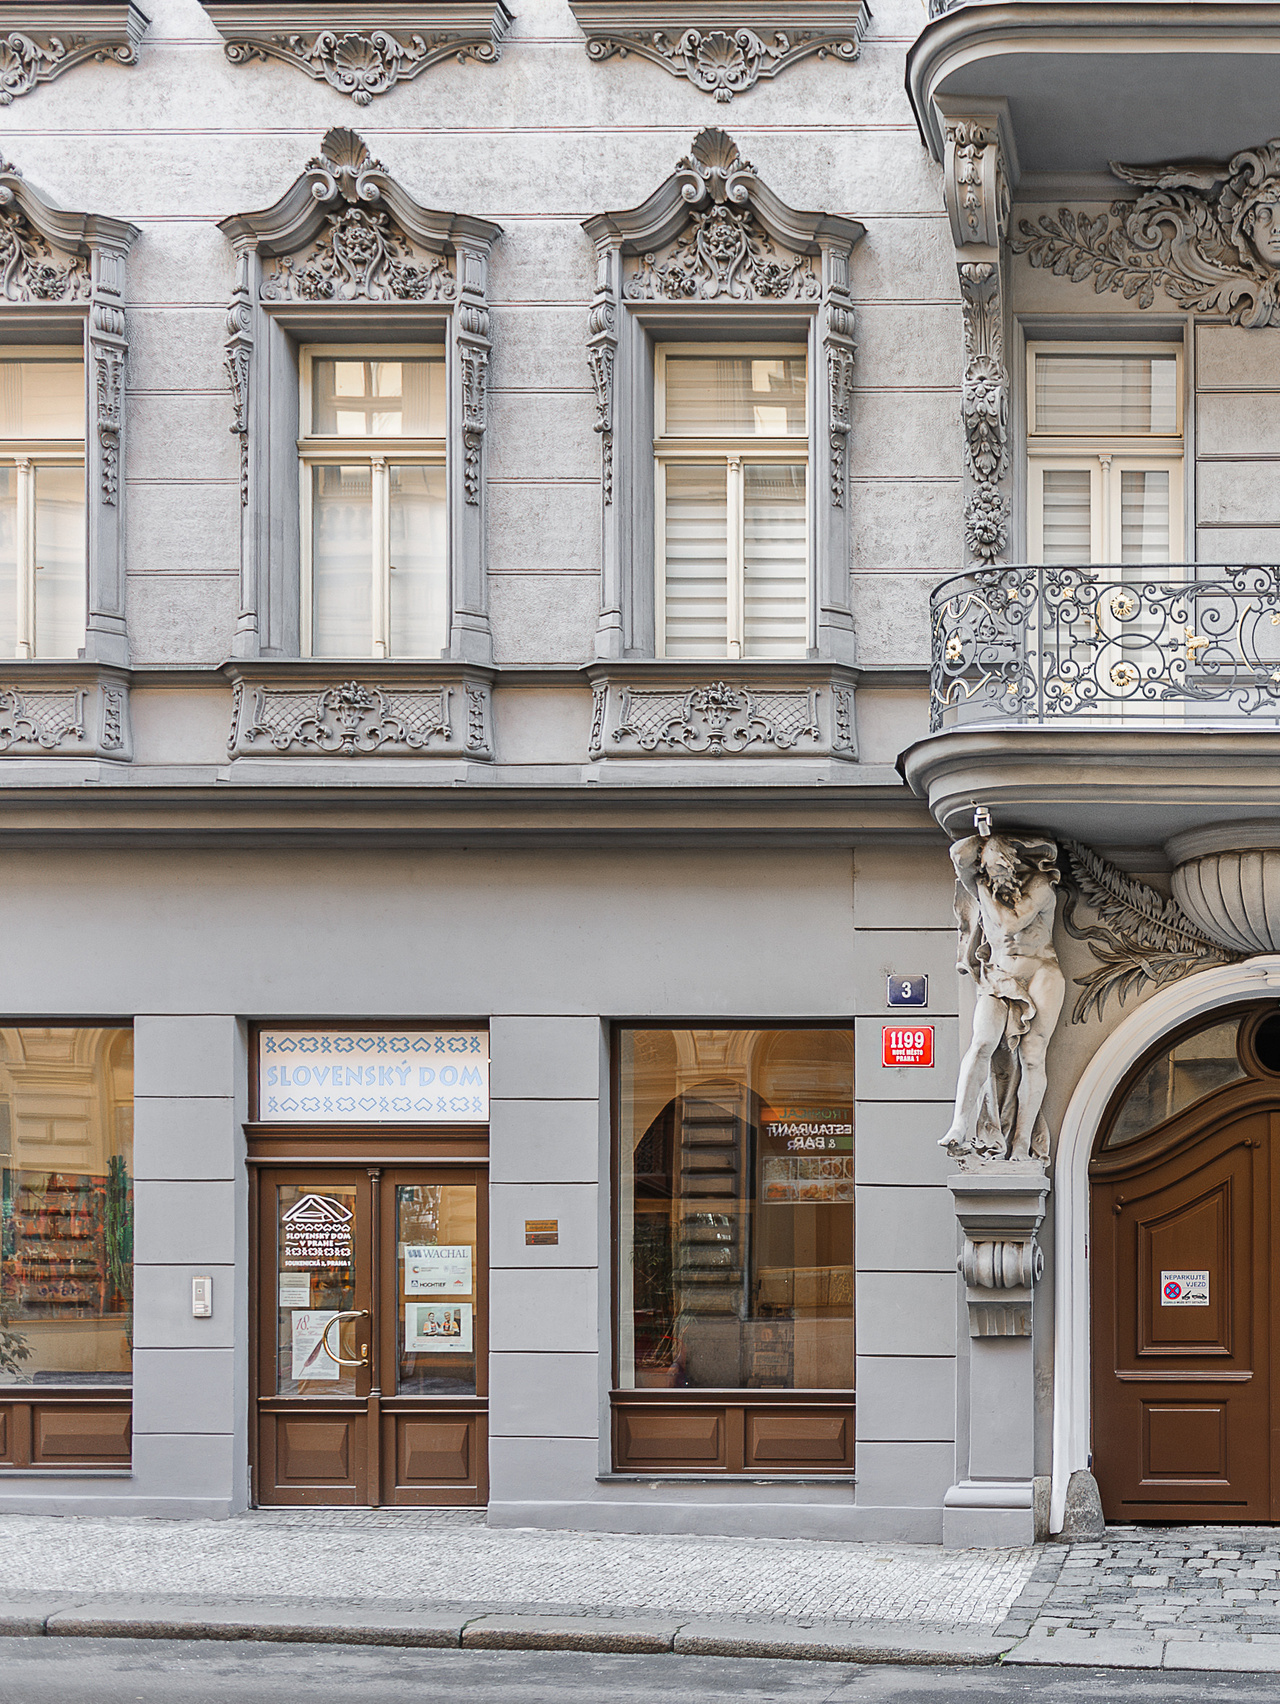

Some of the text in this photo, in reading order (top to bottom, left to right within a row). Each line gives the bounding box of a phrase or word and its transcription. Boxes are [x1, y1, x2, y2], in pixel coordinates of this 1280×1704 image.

[901, 981, 912, 999] 3
[890, 1031, 925, 1049] 1199
[892, 1048, 924, 1056] NOVÉ MĚSTO
[266, 1060, 484, 1087] SLOVENSKÝ DOM
[286, 1231, 331, 1240] SLOVENSKÝ
[423, 1249, 469, 1259] WACHAL
